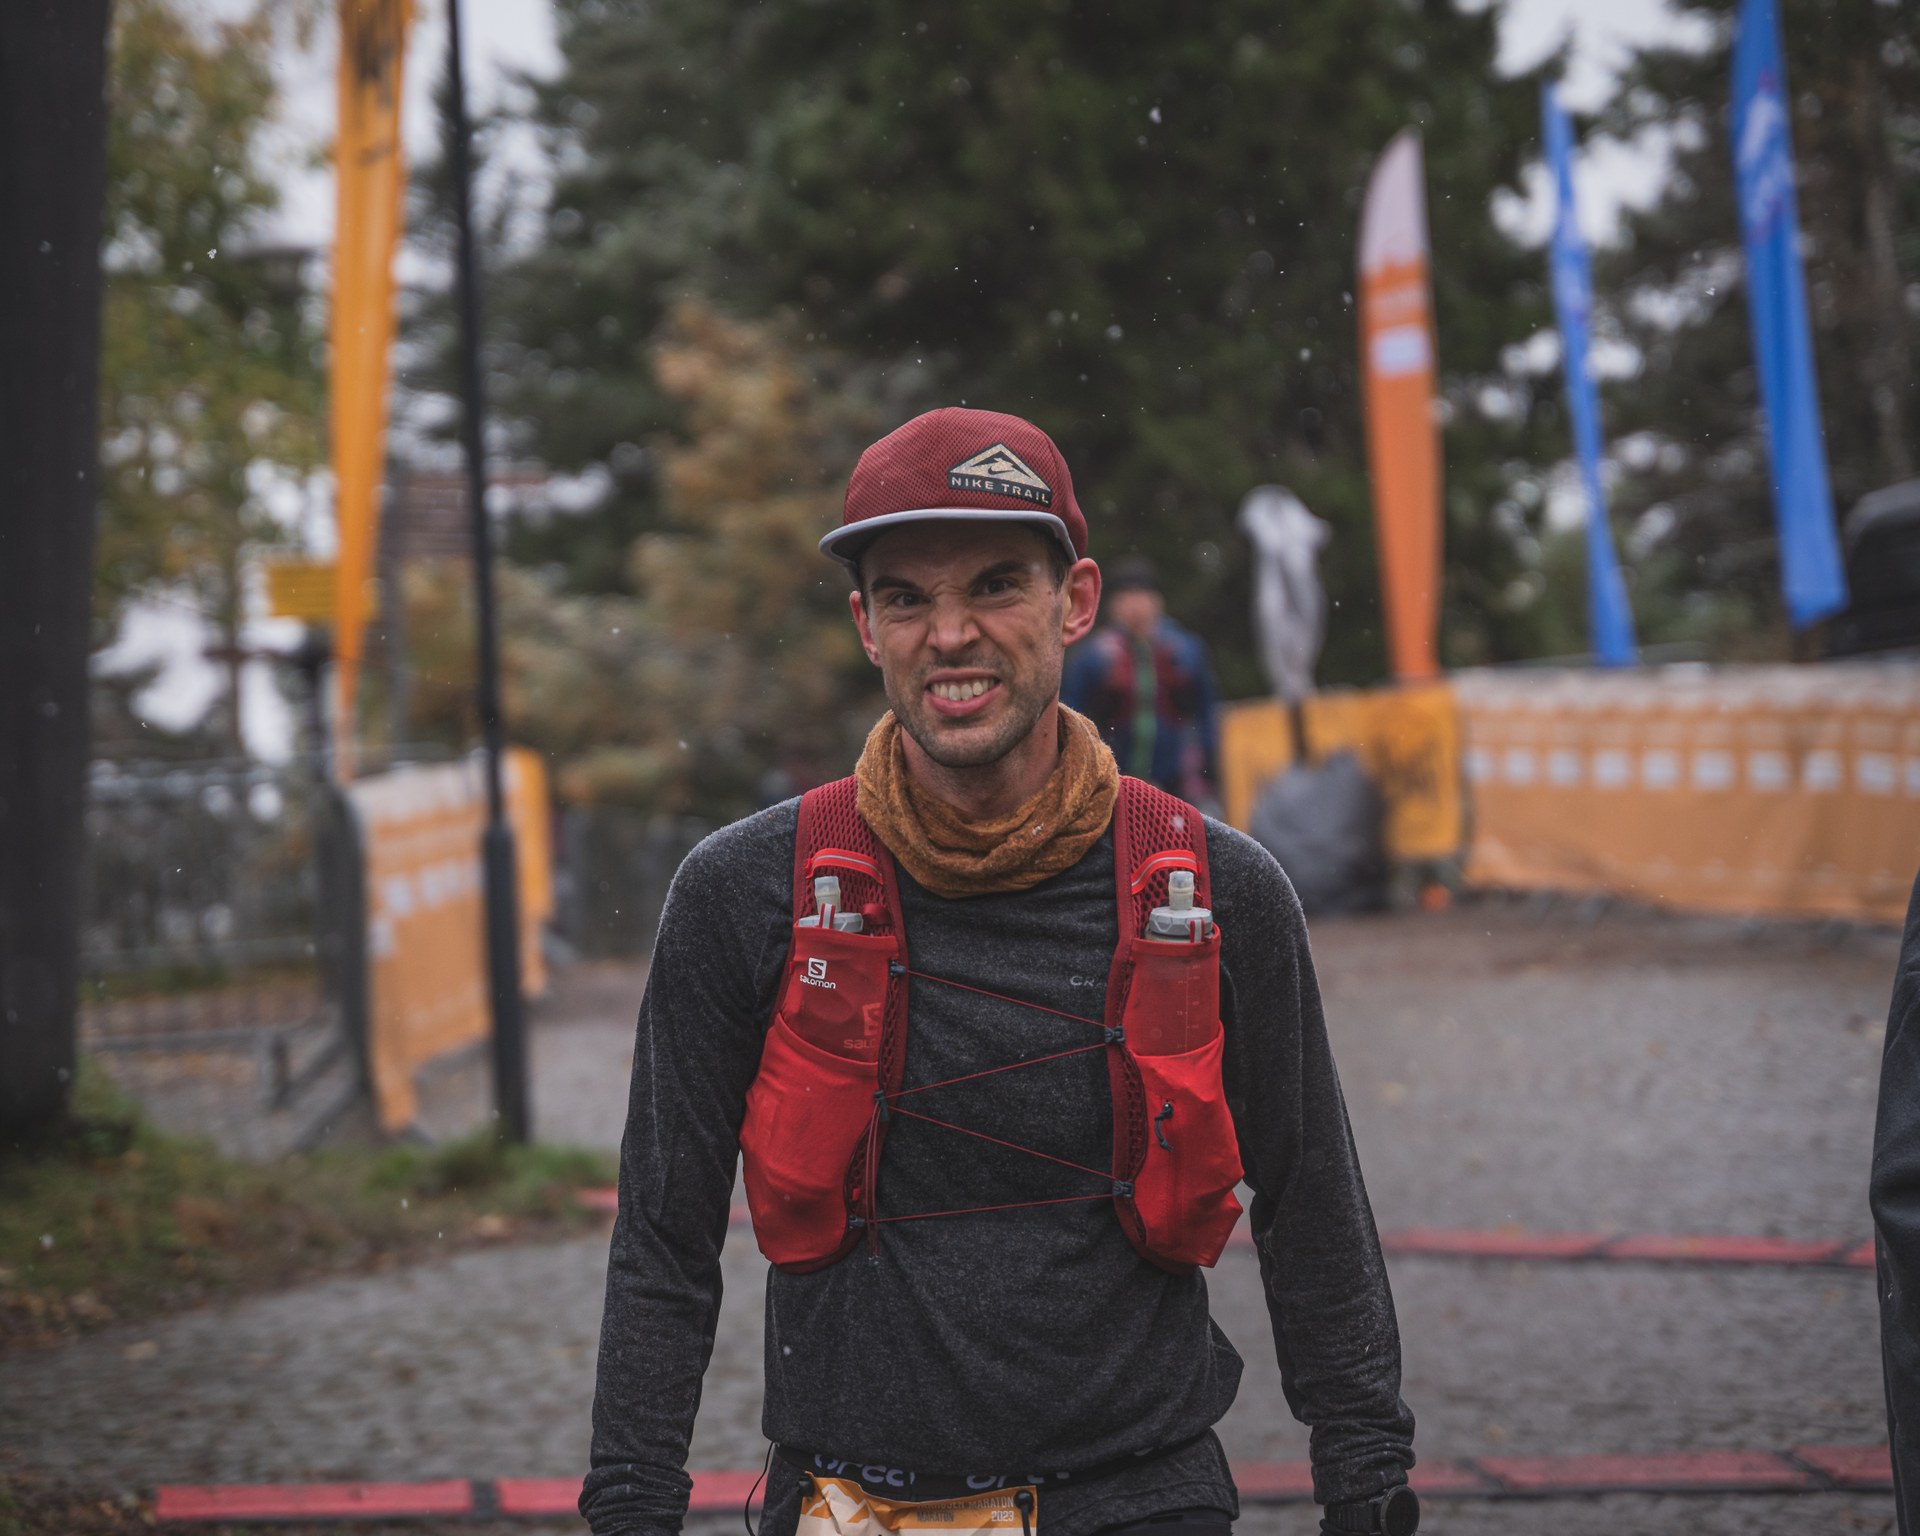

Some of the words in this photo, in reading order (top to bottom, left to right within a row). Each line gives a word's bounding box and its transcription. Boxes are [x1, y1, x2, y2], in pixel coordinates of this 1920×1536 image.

[952, 477, 994, 490] NIKE
[1001, 483, 1049, 504] TRAIL
[991, 1510, 1014, 1522] 2023
